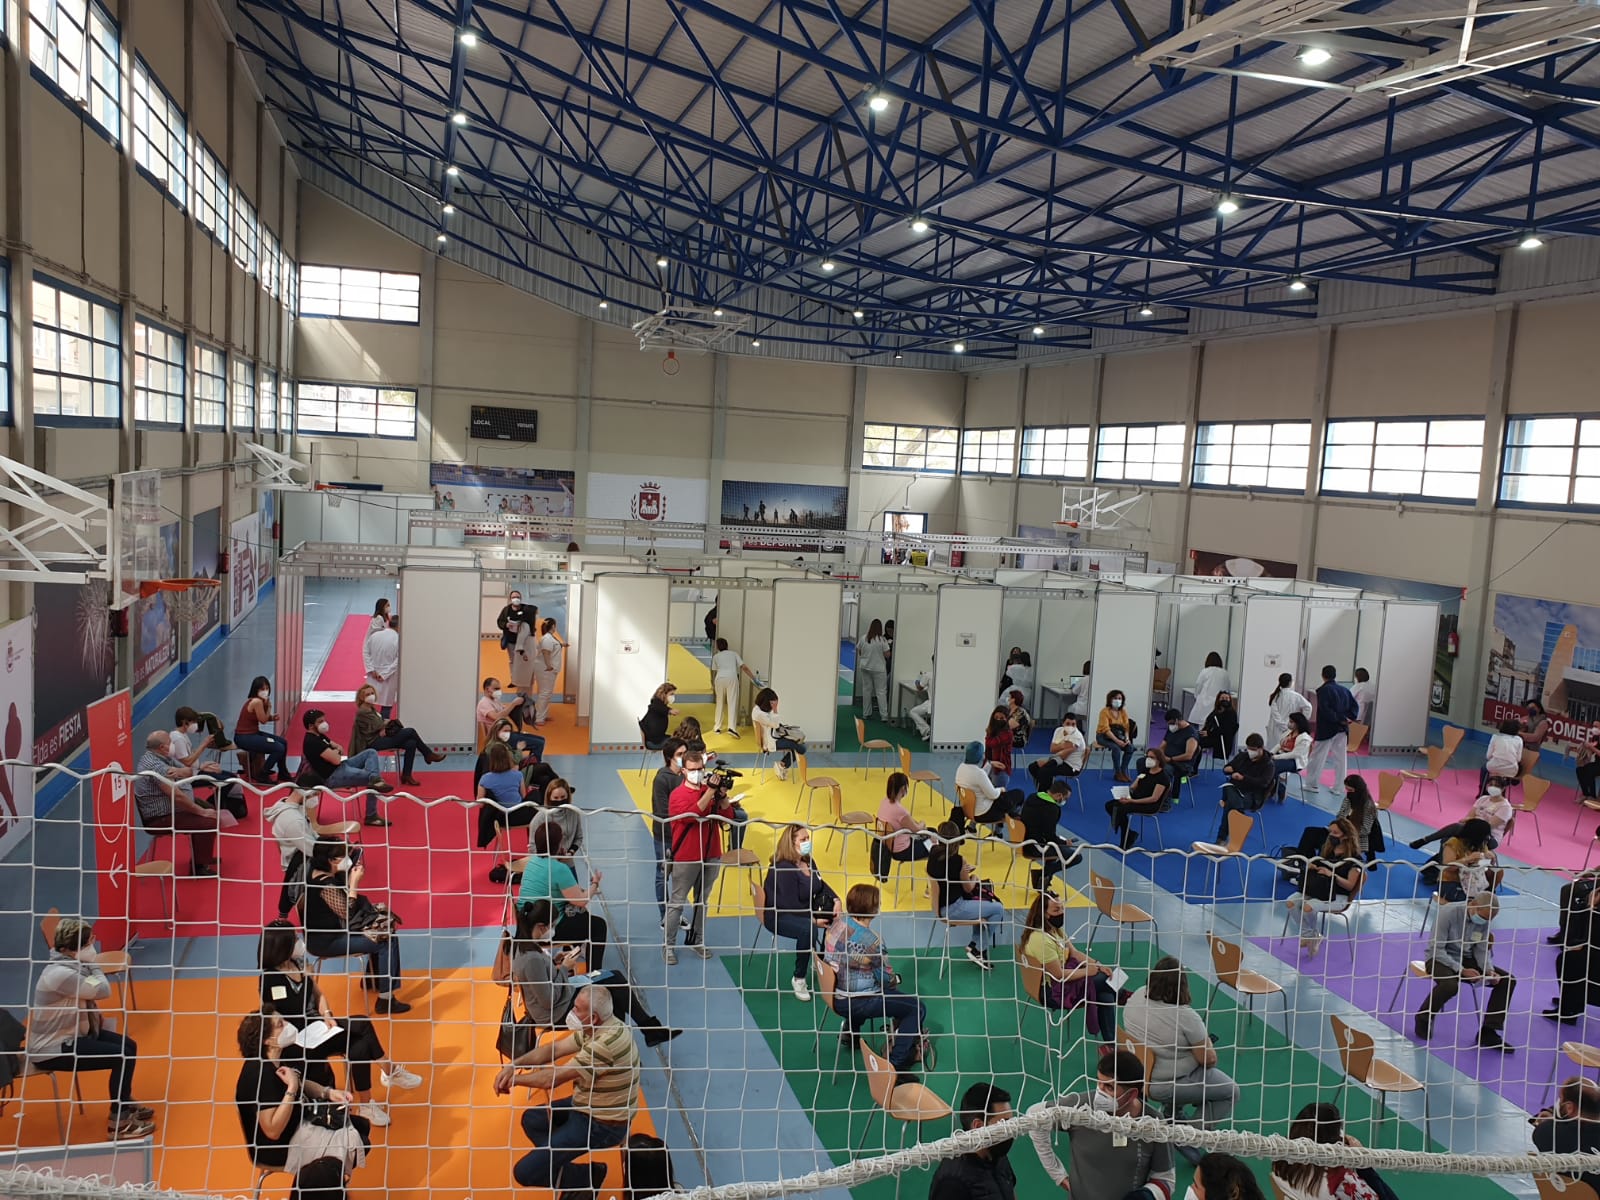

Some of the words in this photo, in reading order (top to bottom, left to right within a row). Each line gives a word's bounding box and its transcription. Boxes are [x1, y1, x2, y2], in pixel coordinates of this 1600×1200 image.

[1494, 705, 1520, 721] Elda
[50, 735, 58, 755] es
[59, 712, 82, 748] FIESTA
